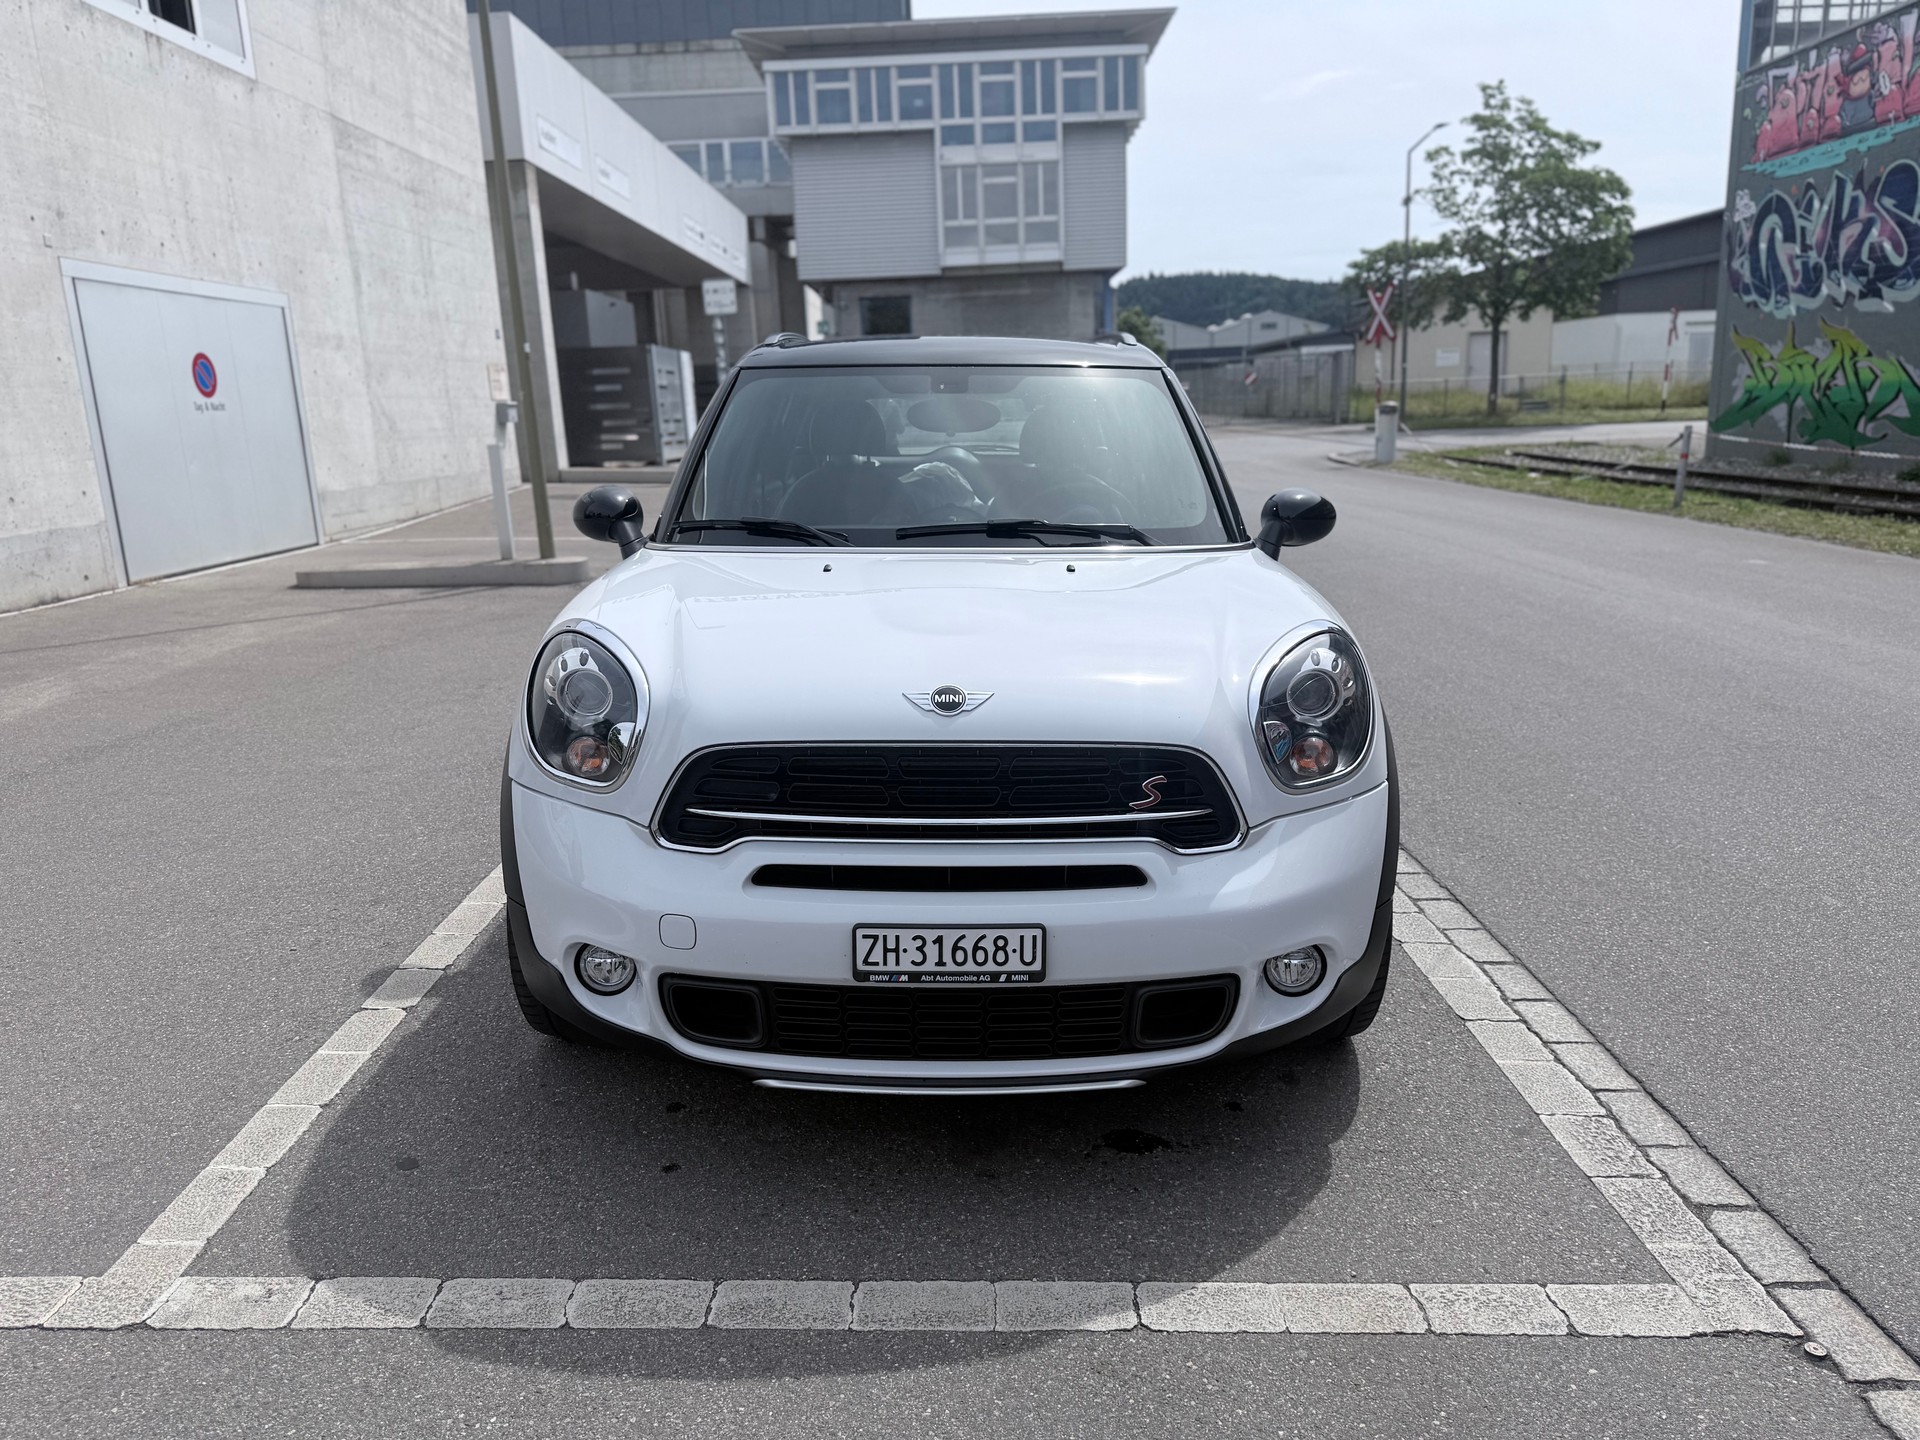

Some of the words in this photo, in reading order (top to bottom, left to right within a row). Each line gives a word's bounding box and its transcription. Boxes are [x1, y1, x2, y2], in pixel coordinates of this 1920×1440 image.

[193, 401, 204, 414] Tag
[934, 694, 963, 703] MINI
[1128, 775, 1167, 810] S
[869, 974, 890, 982] BMW
[920, 974, 934, 982] Abt
[935, 974, 978, 982] Automobile
[978, 974, 991, 982] AG
[1011, 974, 1029, 982] MINI
